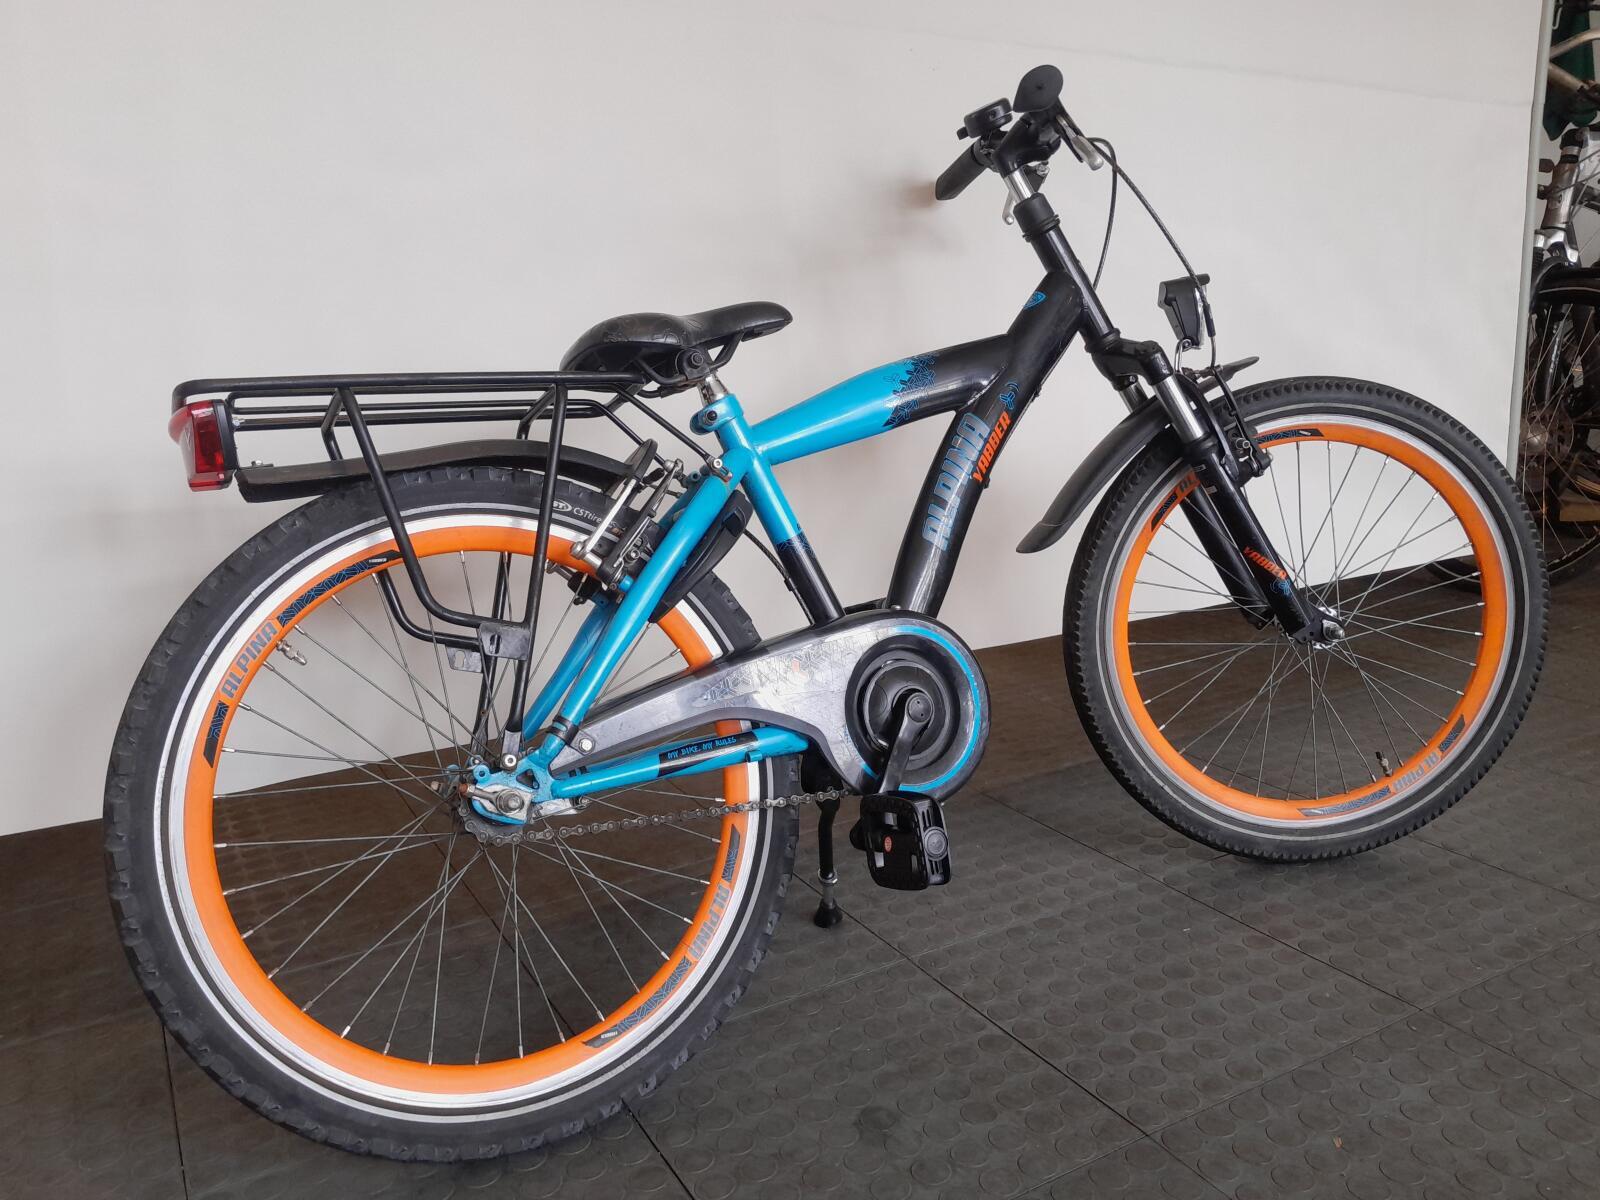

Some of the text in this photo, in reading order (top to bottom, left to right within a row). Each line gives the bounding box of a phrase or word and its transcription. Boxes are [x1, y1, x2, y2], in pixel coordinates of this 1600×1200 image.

[922, 412, 990, 551] ALPINA
[973, 411, 1010, 482] YABBER
[221, 622, 277, 698] ALPINA
[667, 751, 679, 760] MY
[702, 742, 713, 751] MY
[715, 736, 737, 747] RULES
[689, 884, 730, 960] ALPINA
